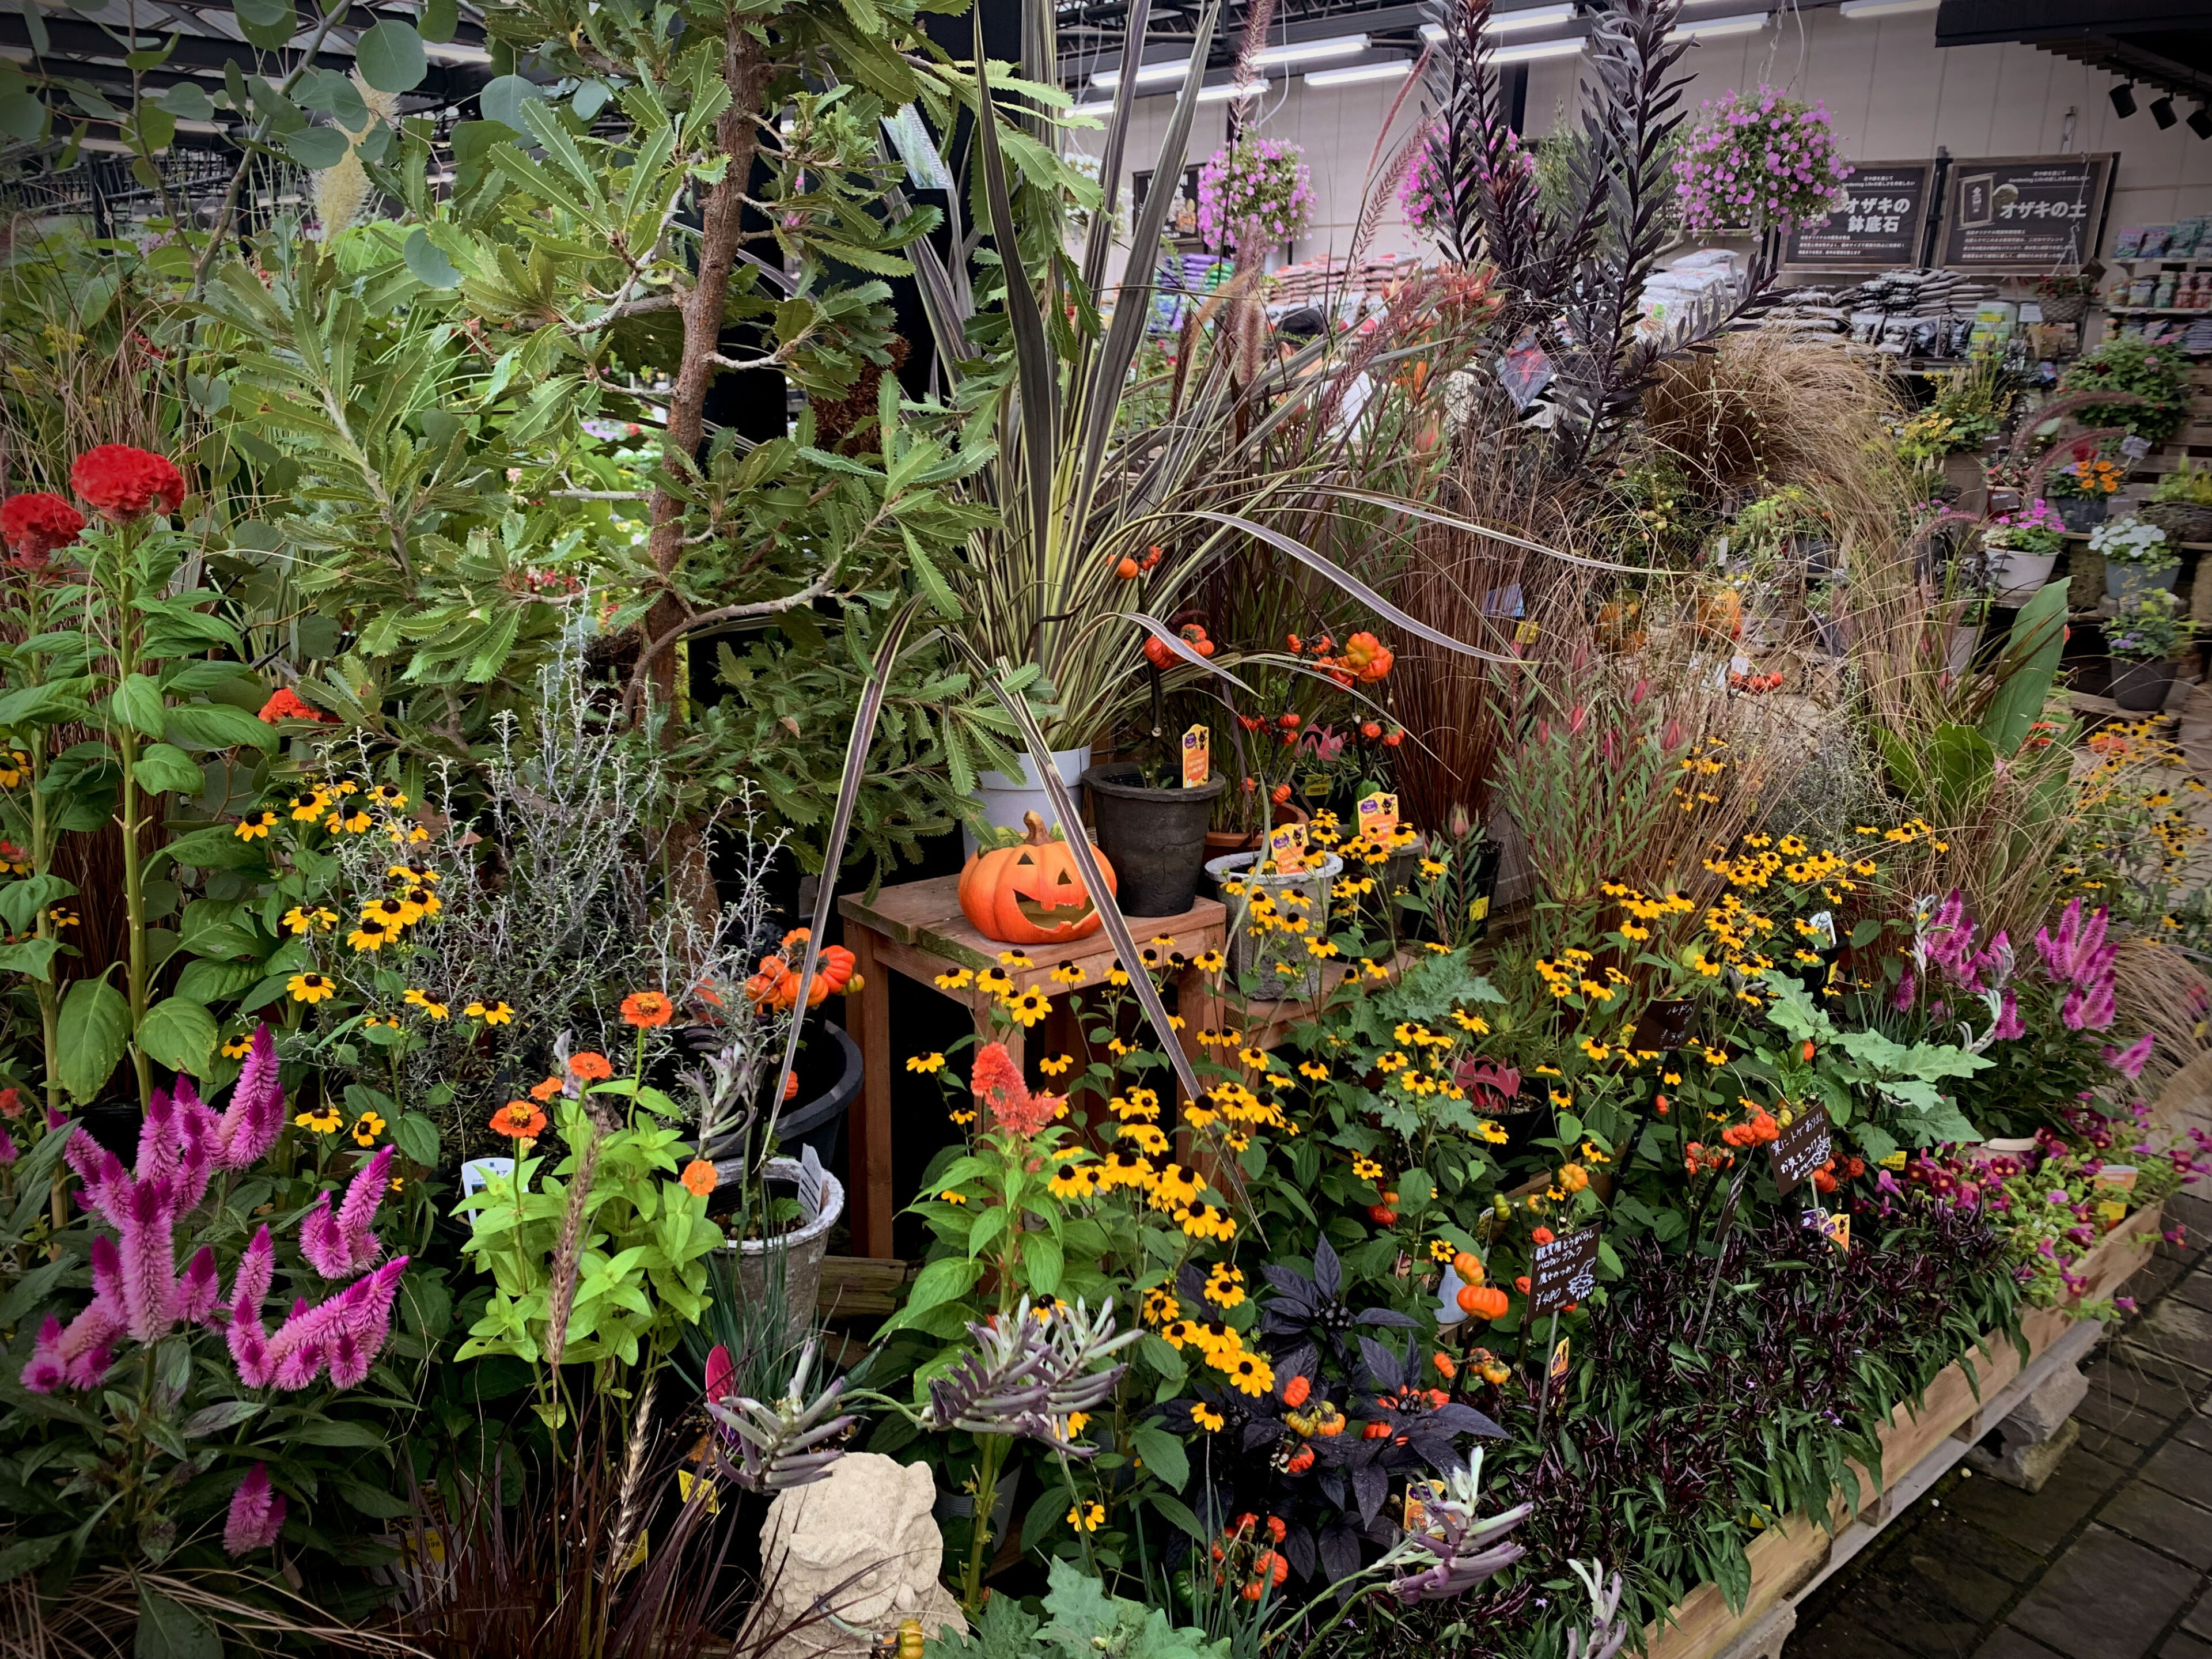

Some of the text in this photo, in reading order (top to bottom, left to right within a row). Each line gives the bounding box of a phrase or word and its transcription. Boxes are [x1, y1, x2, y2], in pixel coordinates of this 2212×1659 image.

[1844, 198, 1911, 214] オザキの
[1999, 199, 2087, 219] オザキの土
[1847, 215, 1900, 233] 鉢底石
